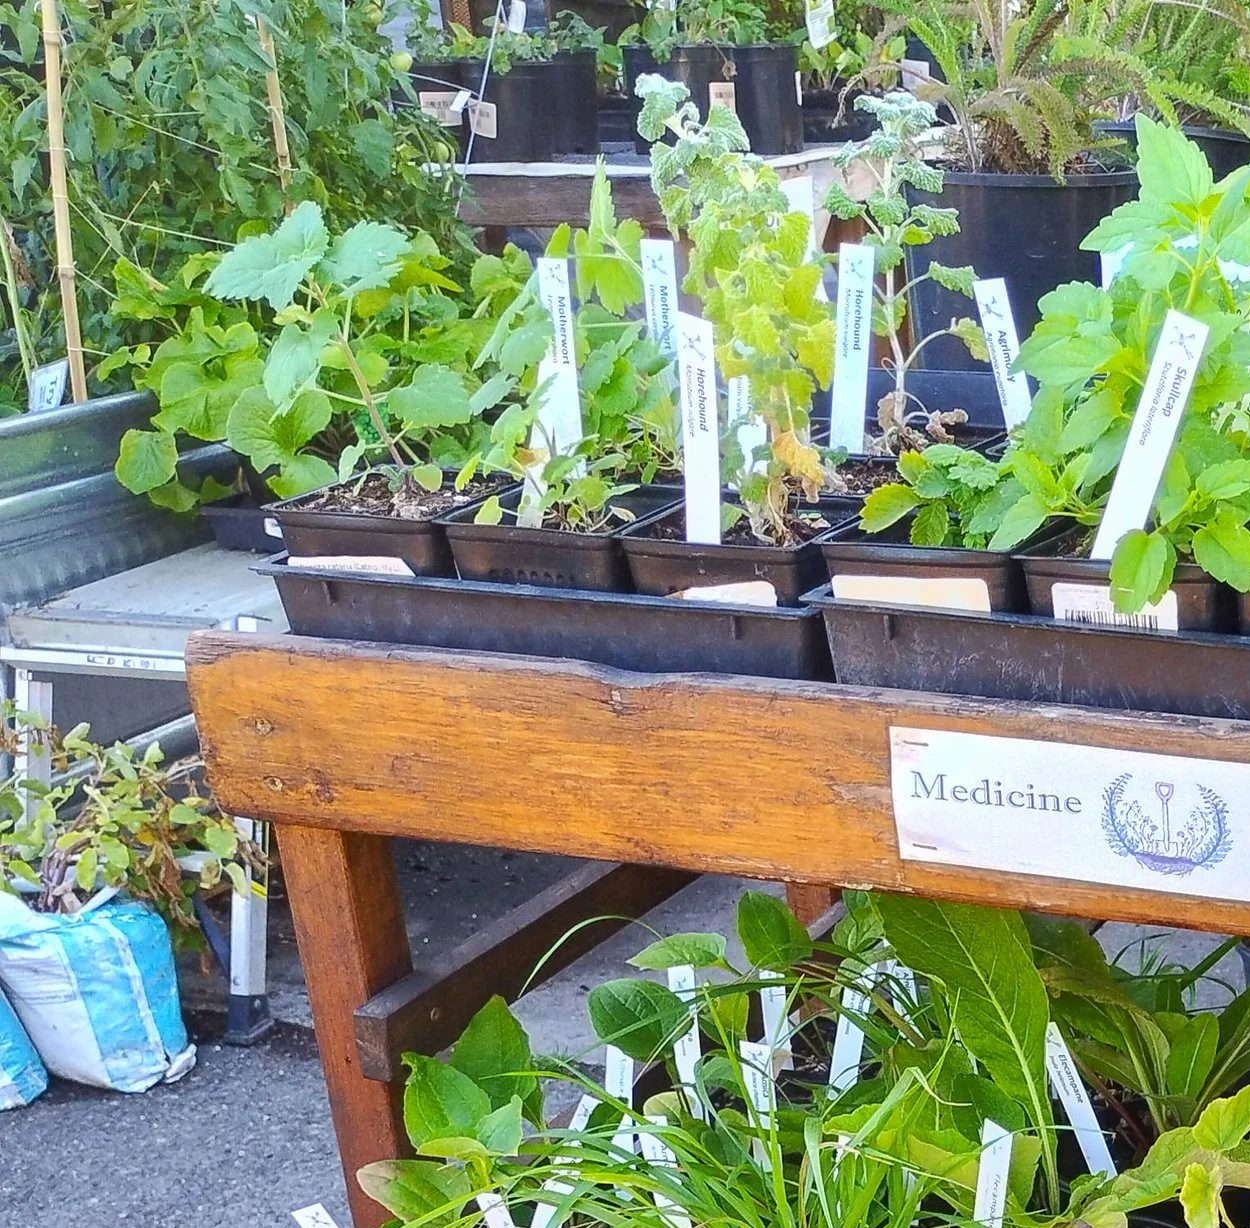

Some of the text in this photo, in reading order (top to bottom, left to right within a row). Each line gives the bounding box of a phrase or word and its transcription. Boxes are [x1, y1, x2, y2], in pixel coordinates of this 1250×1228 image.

[558, 296, 570, 365] Motherwort
[853, 290, 865, 350] Horehound
[998, 330, 1016, 383] Agrimoy
[697, 369, 709, 432] Horehound
[1139, 362, 1172, 446] Scutellaria lateriflora
[1162, 366, 1187, 417] Skullcap
[910, 770, 1082, 814] Medicine
[1059, 1054, 1083, 1103] Elecampane
